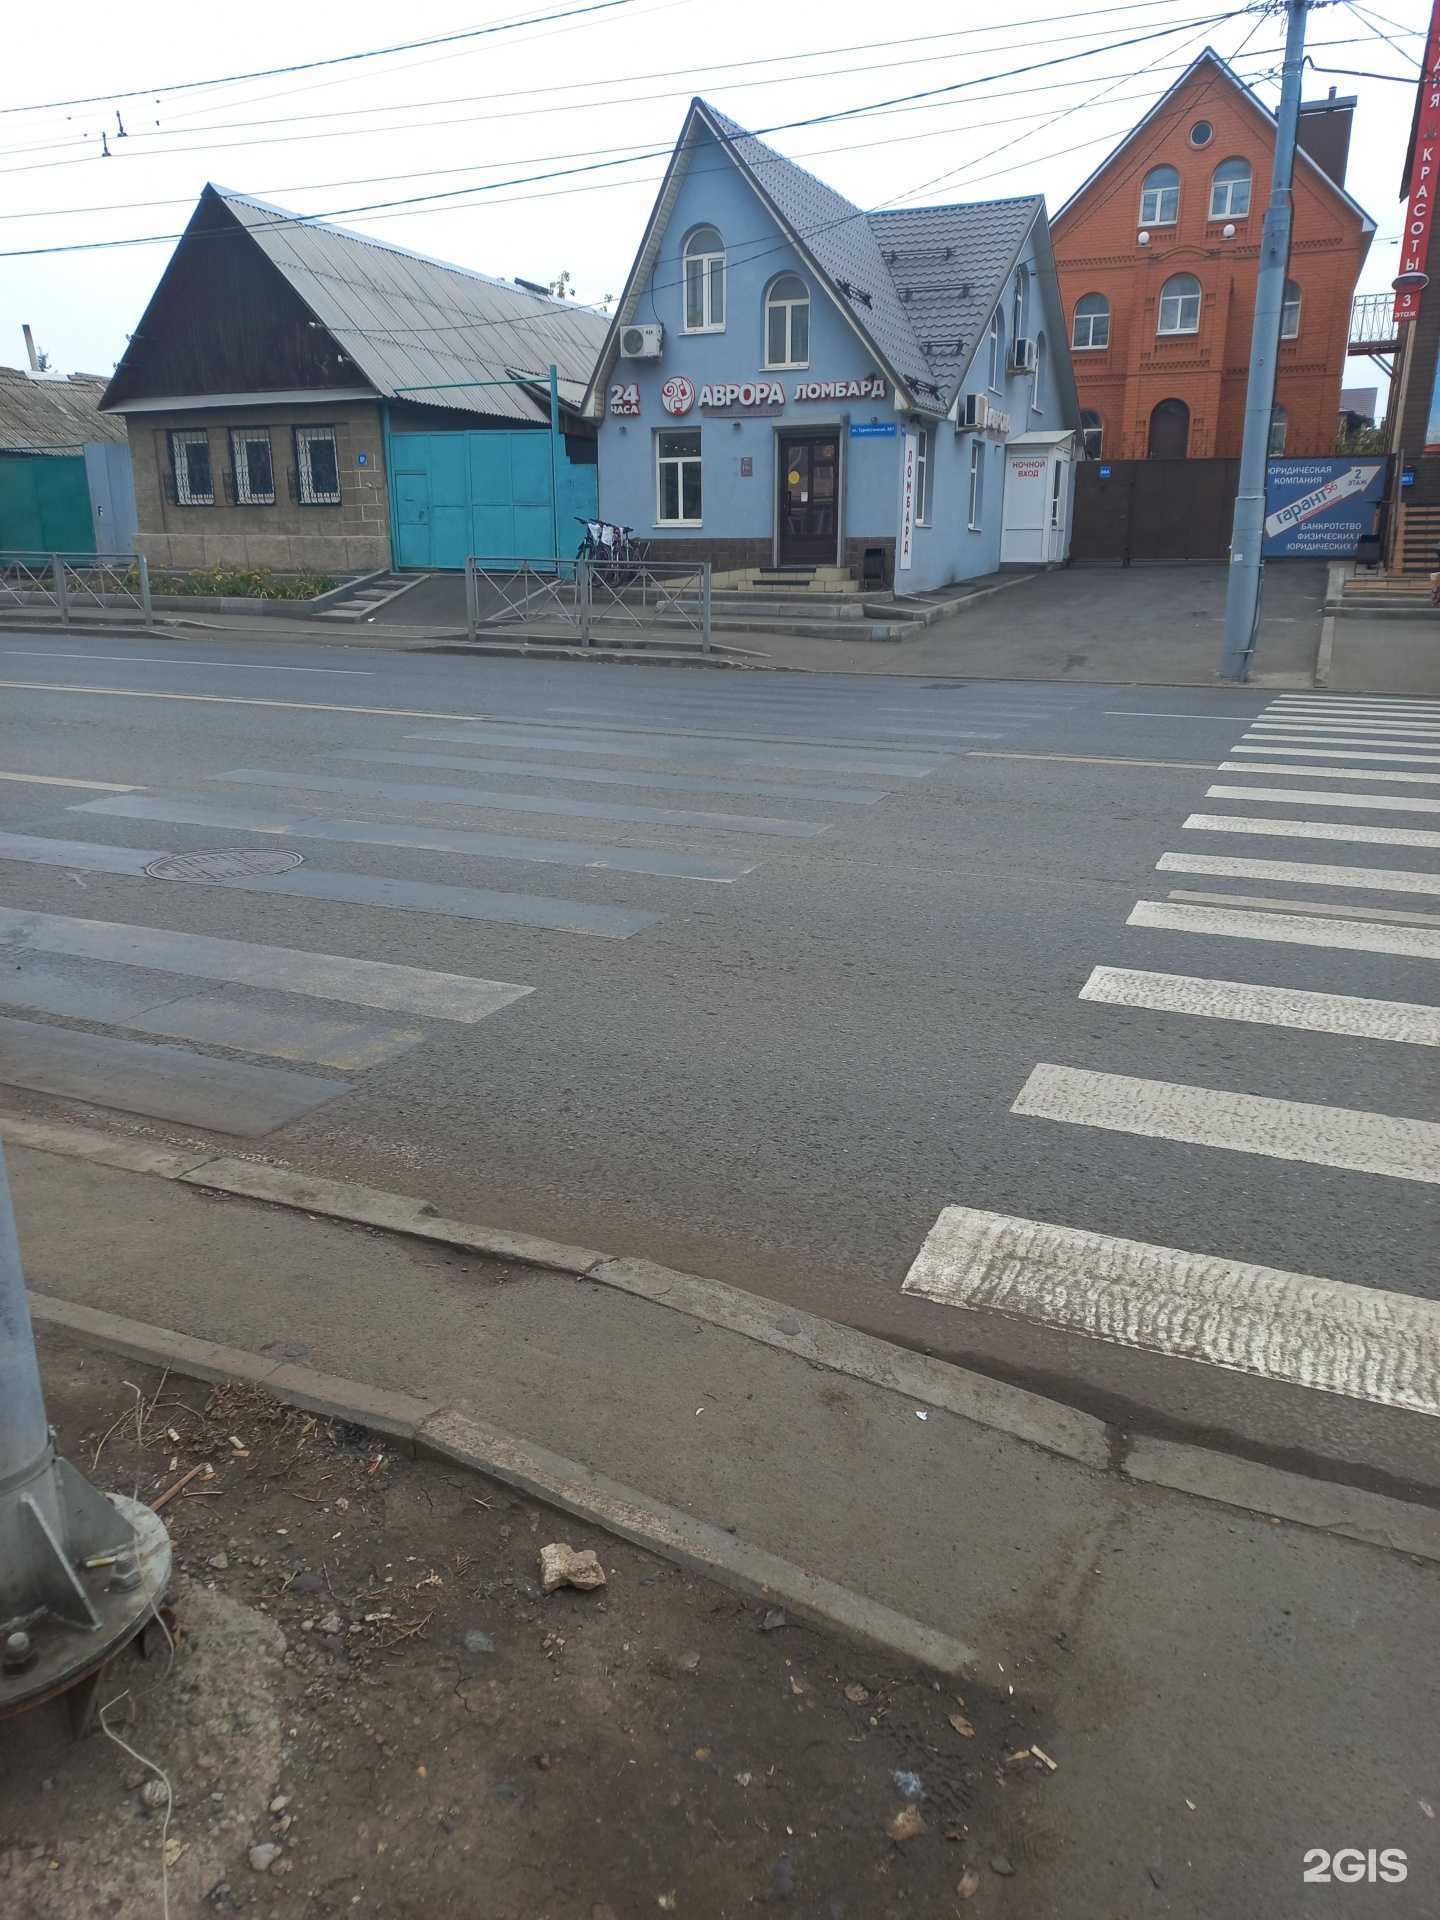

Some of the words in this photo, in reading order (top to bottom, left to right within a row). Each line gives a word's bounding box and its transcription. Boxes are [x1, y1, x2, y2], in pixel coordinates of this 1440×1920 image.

[1405, 148, 1434, 272] КРАСОТЫ
[1402, 294, 1412, 307] 3
[610, 384, 640, 404] 24
[698, 383, 785, 407] АВРОРА
[794, 380, 886, 401] ЛОМБАРД
[610, 404, 639, 415] ЧАСА
[1012, 460, 1046, 469] НОЧНОЙ
[1018, 470, 1039, 478] ВХОД
[1354, 469, 1362, 479] 2
[1274, 476, 1323, 486] КОМПАНИЯ
[904, 450, 913, 556] ЛОМБАРД
[1301, 521, 1362, 531] БАНКРОТСТВО
[1297, 532, 1355, 541] ФИЗИЧЕСКИХ
[1286, 542, 1352, 551] ЮРИДИЧЕСКИХ
